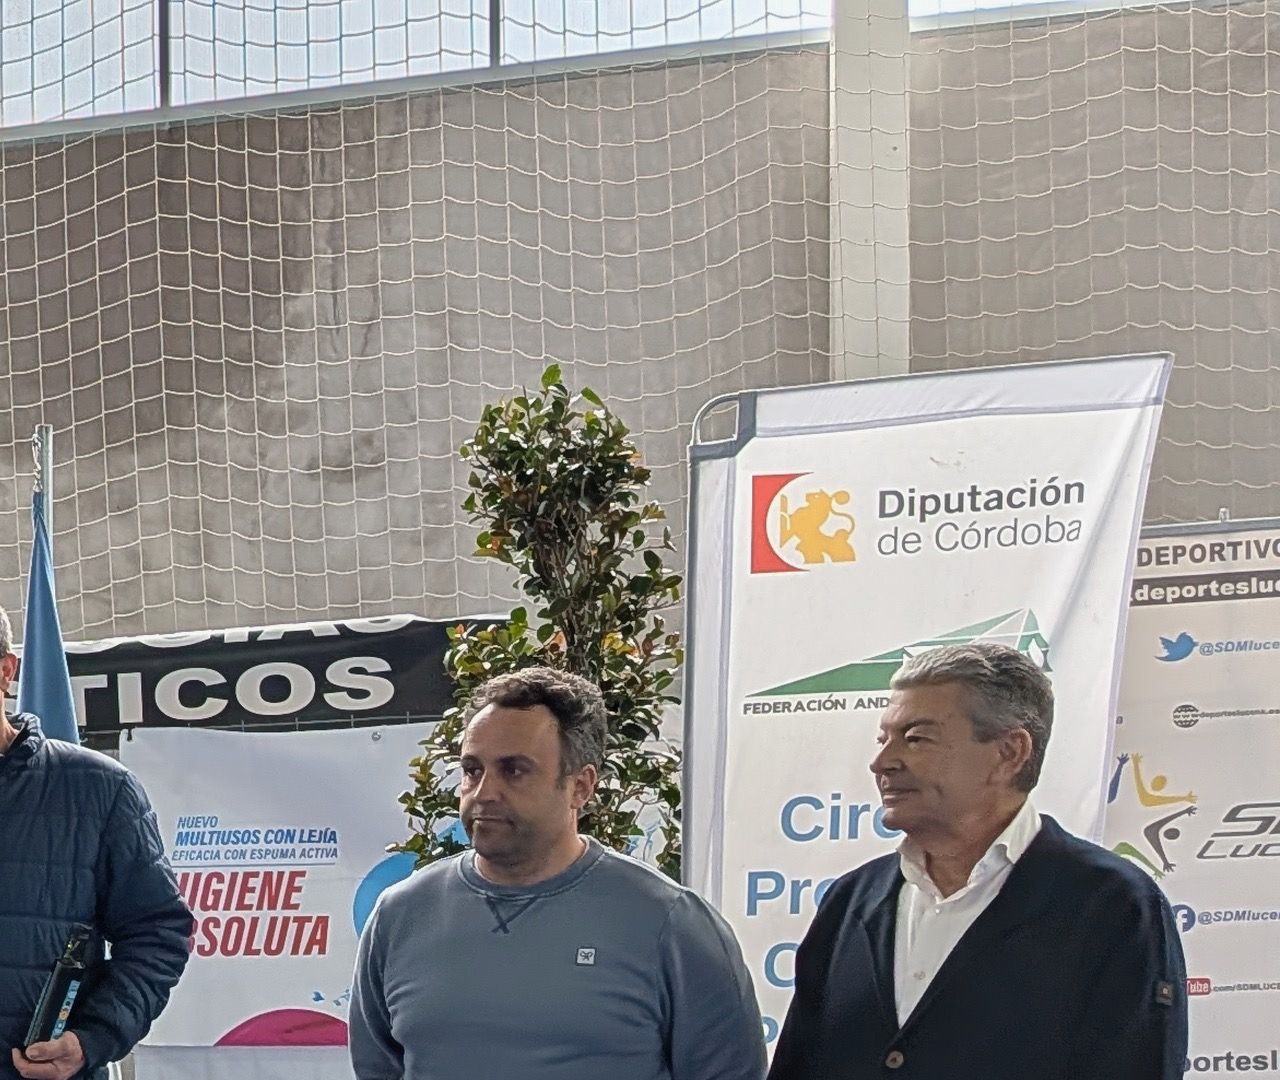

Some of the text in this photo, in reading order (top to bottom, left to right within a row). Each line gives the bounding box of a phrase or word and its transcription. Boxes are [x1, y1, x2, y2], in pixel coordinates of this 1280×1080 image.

[878, 476, 1085, 522] Diputación
[877, 515, 1083, 556] de Córdoba
[743, 695, 846, 715] FEDERACIÓN
[177, 816, 219, 829] NUEVO
[175, 827, 338, 846] MULTIUSOS CON LEJÍA
[171, 848, 338, 861] EFICACIA CON ESPUMA ACTIVA
